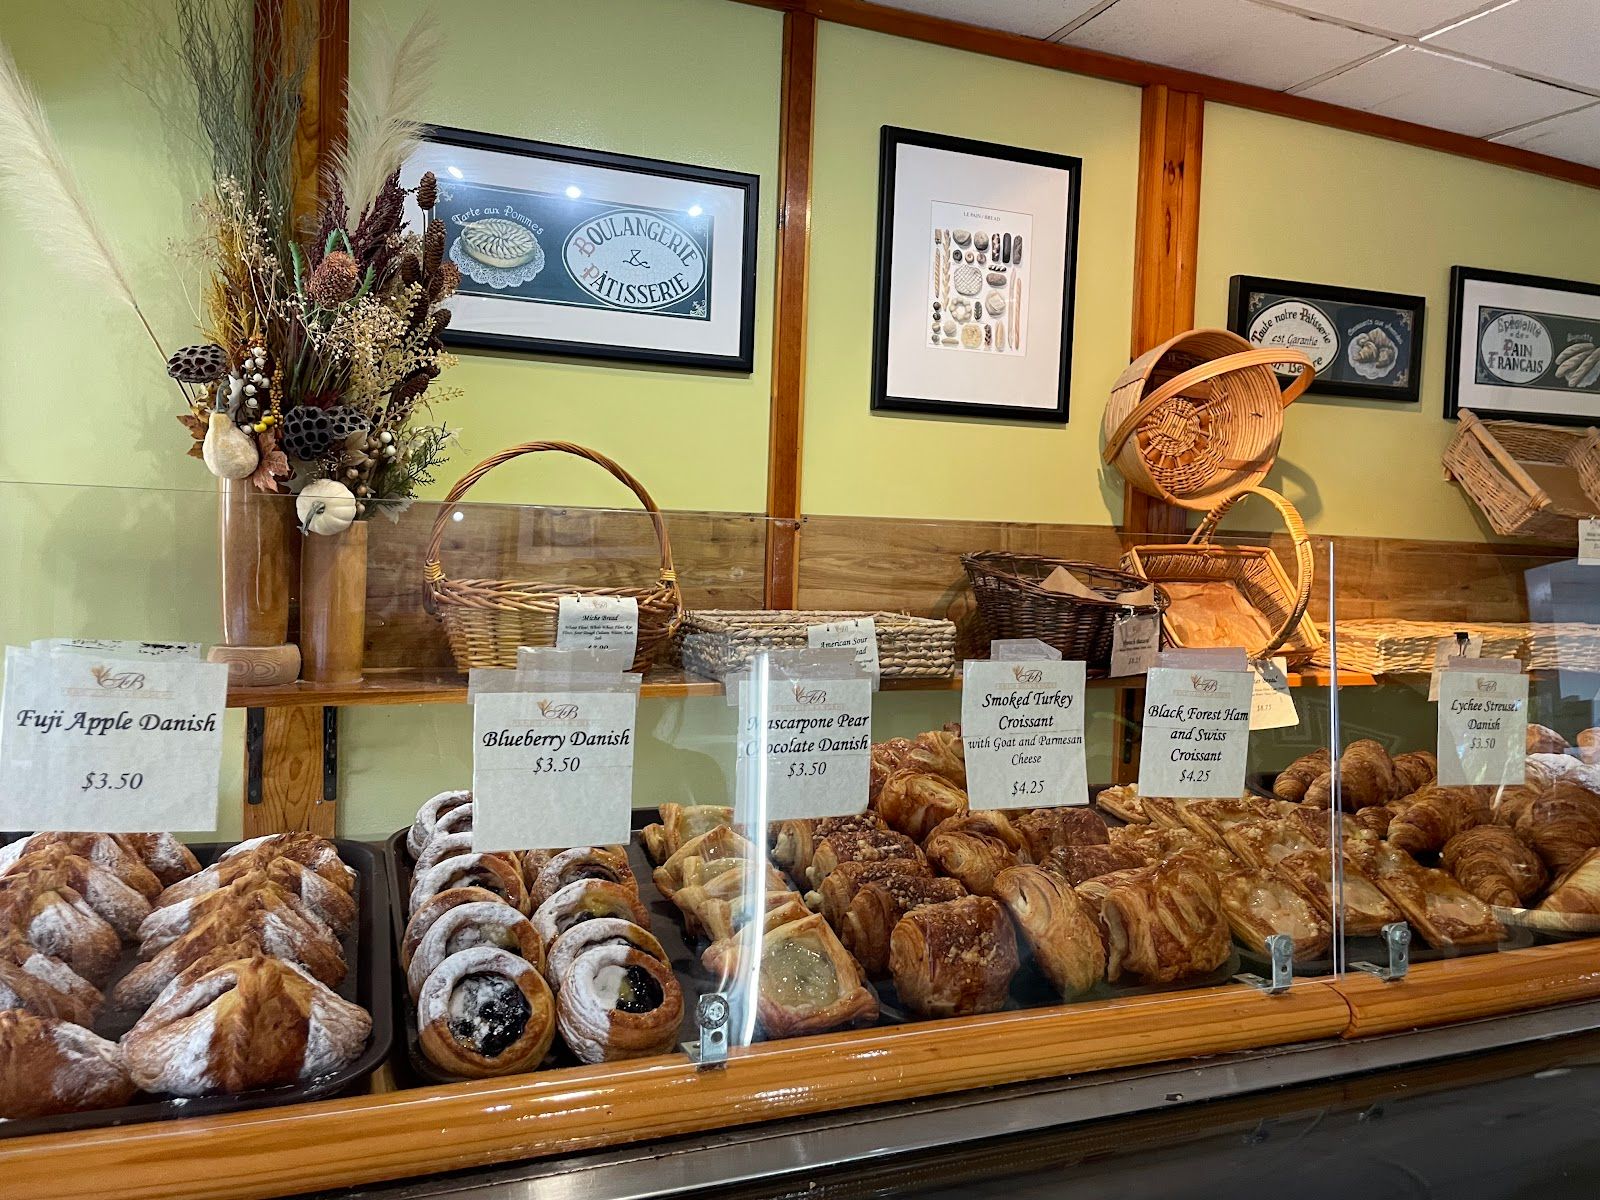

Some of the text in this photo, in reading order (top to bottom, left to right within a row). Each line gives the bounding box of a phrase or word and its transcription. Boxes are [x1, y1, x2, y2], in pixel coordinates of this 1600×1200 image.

[451, 205, 545, 236] Tarte aux Pommes
[572, 215, 698, 268] BOULANGERIE
[621, 248, 651, 270] &
[580, 264, 690, 304] PÂTISSERIE
[1275, 308, 1298, 322] notre
[1503, 339, 1533, 358] PAIN
[820, 637, 868, 648] American Sour
[982, 690, 1074, 709] Smoked Turkey
[1451, 698, 1484, 714] Lychee
[16, 708, 217, 735] Fuji Apple Danish
[837, 713, 870, 728] Pear
[1148, 704, 1249, 722] Black Forest Ham
[998, 715, 1054, 730] Croissant
[1467, 718, 1501, 731] Danish
[482, 728, 631, 751] Blueberry Danish
[968, 734, 1083, 751] with Goat and Parmesan
[1170, 727, 1227, 742] and Swiss
[746, 734, 869, 756] Cocolate Danish
[1469, 737, 1496, 750] $3.50
[1011, 752, 1042, 766] Cheese
[1170, 748, 1223, 762] Croissant
[533, 757, 581, 775] $3.50
[787, 761, 827, 780] $3.50
[82, 771, 144, 792] $3.50
[1179, 769, 1212, 783] $4.25
[1012, 780, 1045, 796] $4.25
